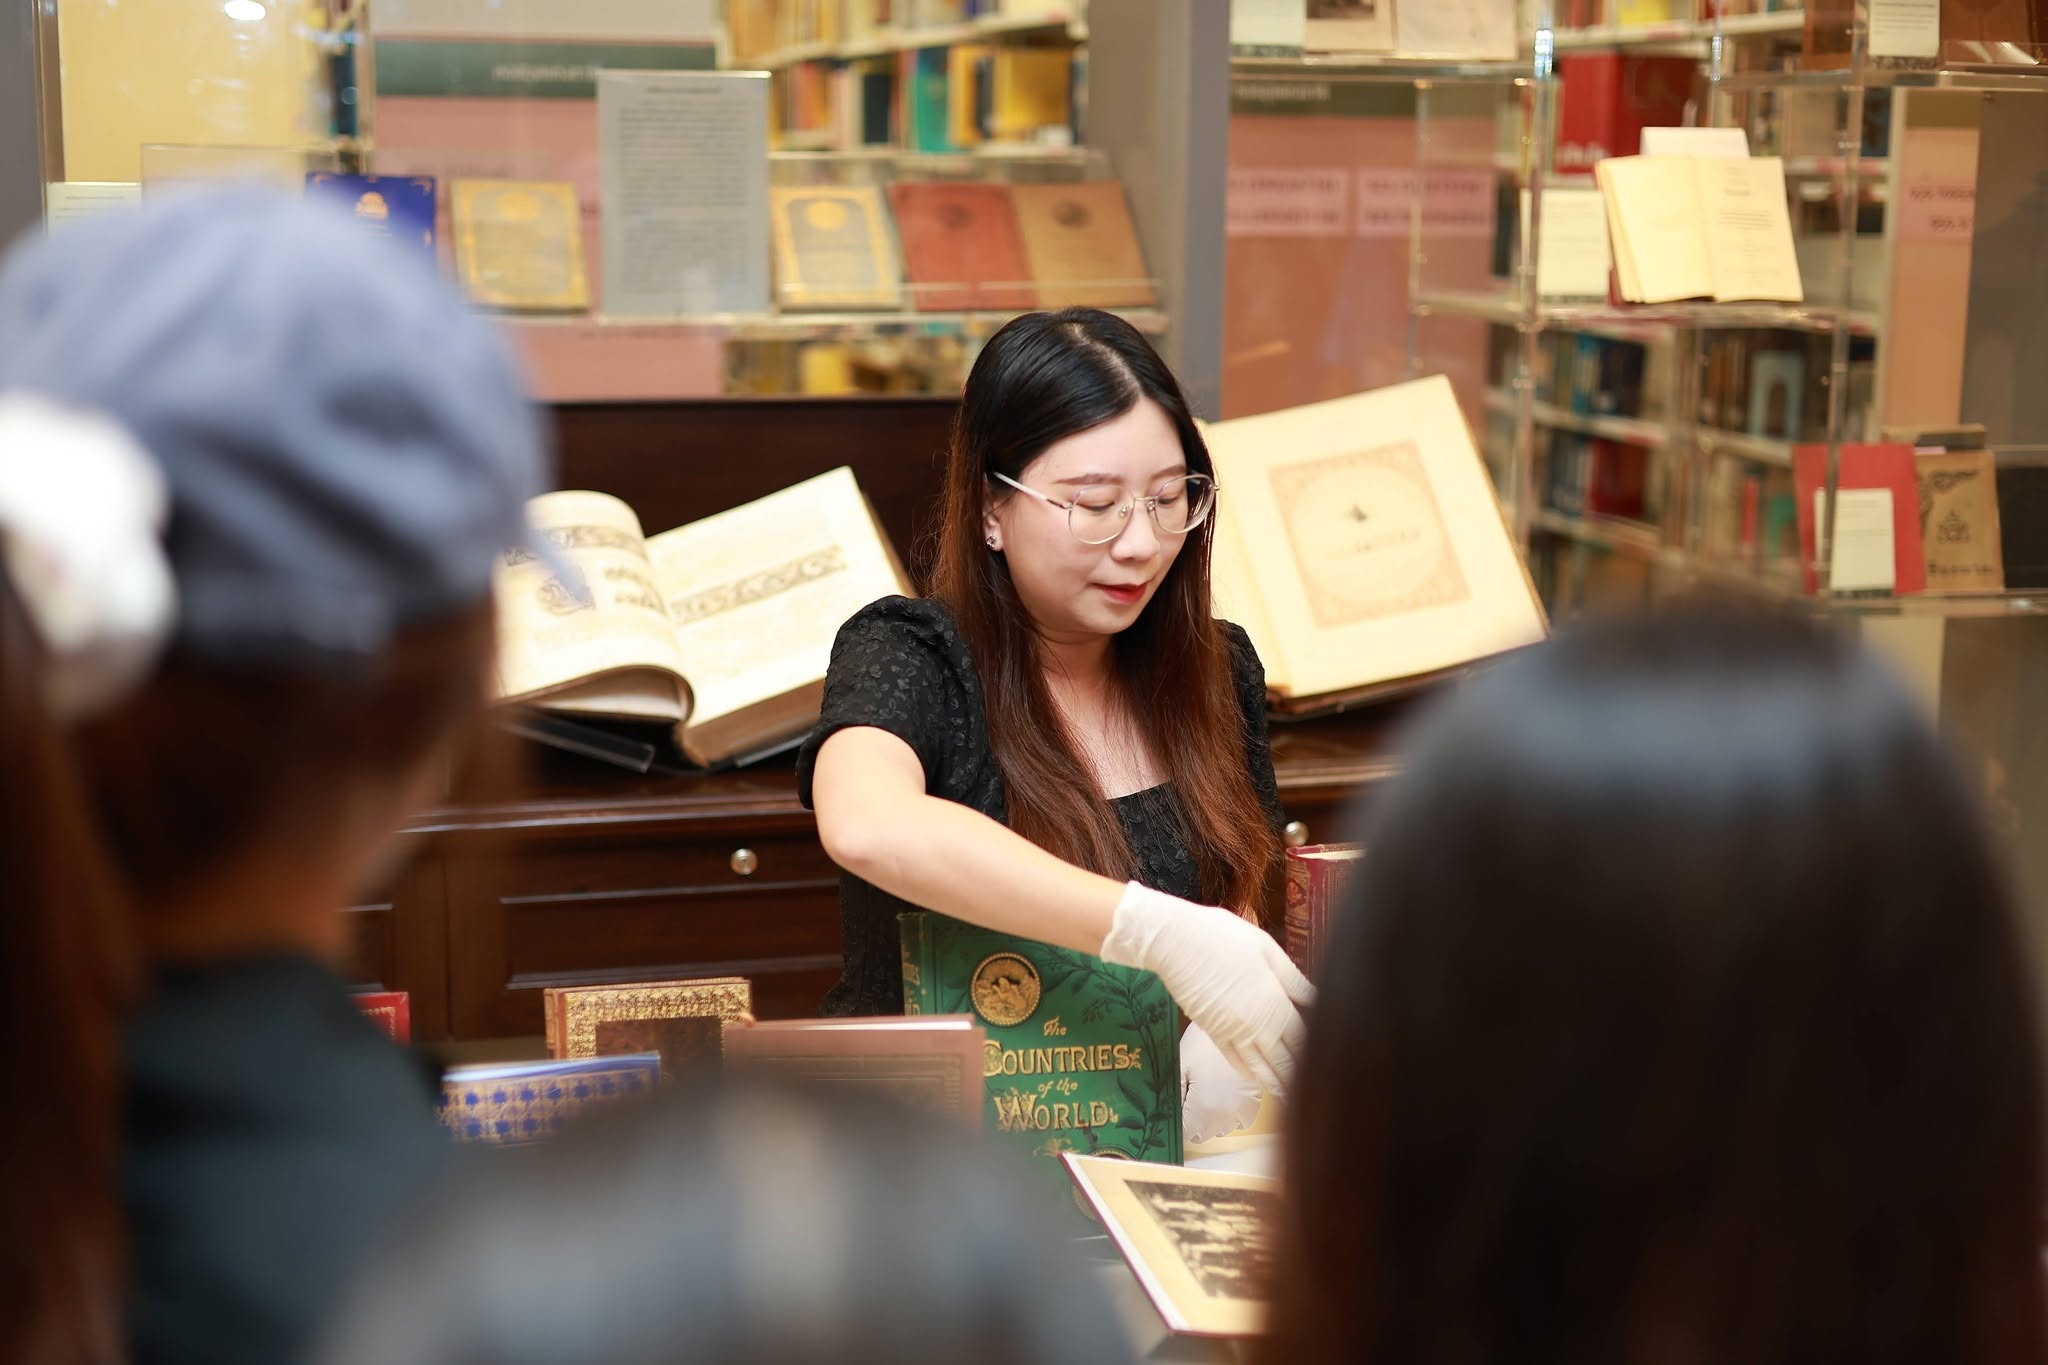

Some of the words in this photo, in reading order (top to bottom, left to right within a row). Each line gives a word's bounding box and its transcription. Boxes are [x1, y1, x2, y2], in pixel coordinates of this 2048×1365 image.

[1043, 1016, 1067, 1036] The
[1038, 1079, 1054, 1098] of
[1056, 1078, 1078, 1096] the
